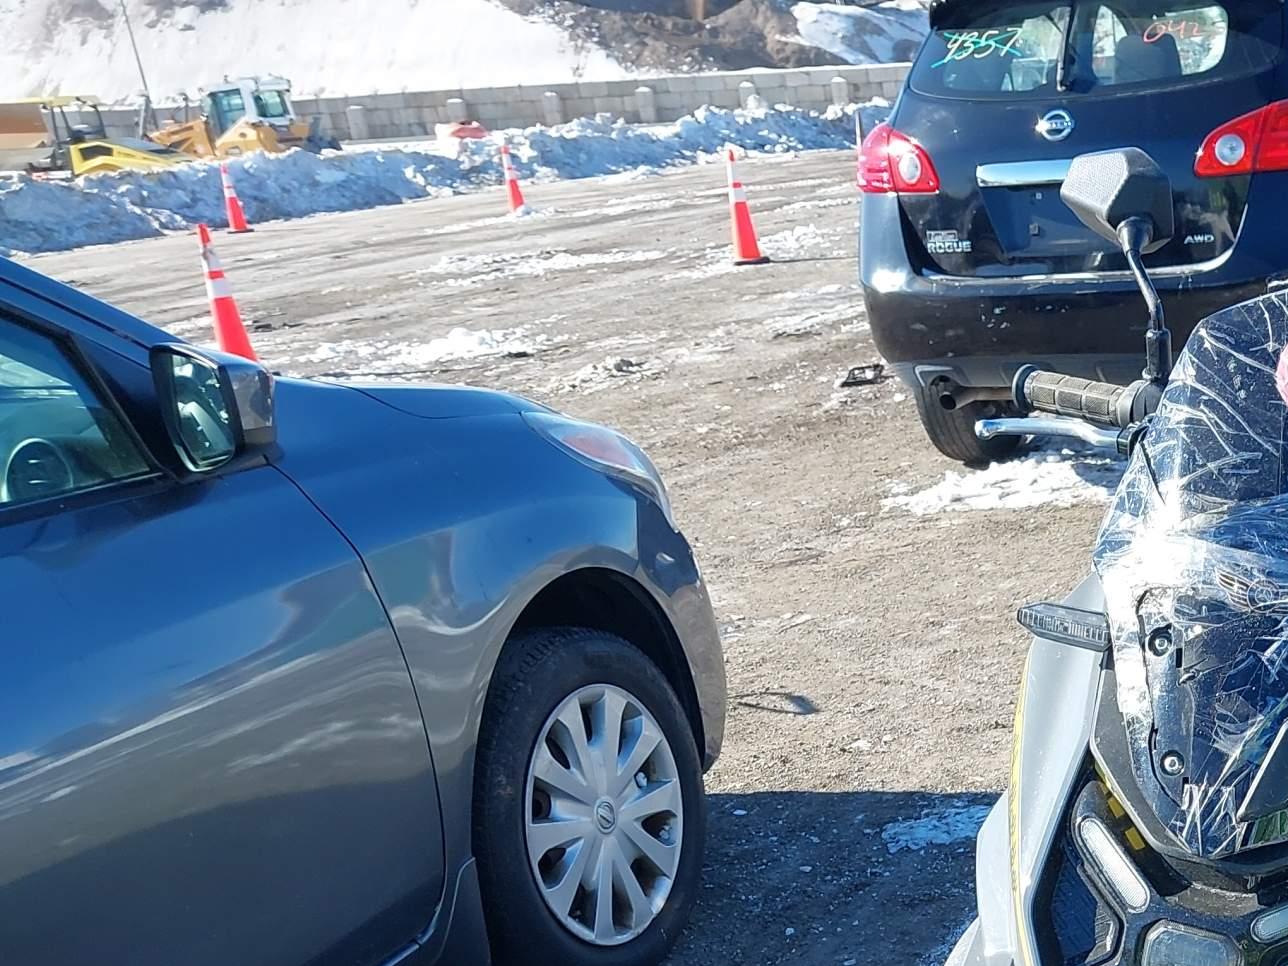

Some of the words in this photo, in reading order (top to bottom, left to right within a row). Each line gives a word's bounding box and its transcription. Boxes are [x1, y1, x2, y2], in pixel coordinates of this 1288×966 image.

[944, 27, 1023, 63] 4357
[1183, 234, 1215, 245] AWD
[926, 240, 972, 254] ROGUE
